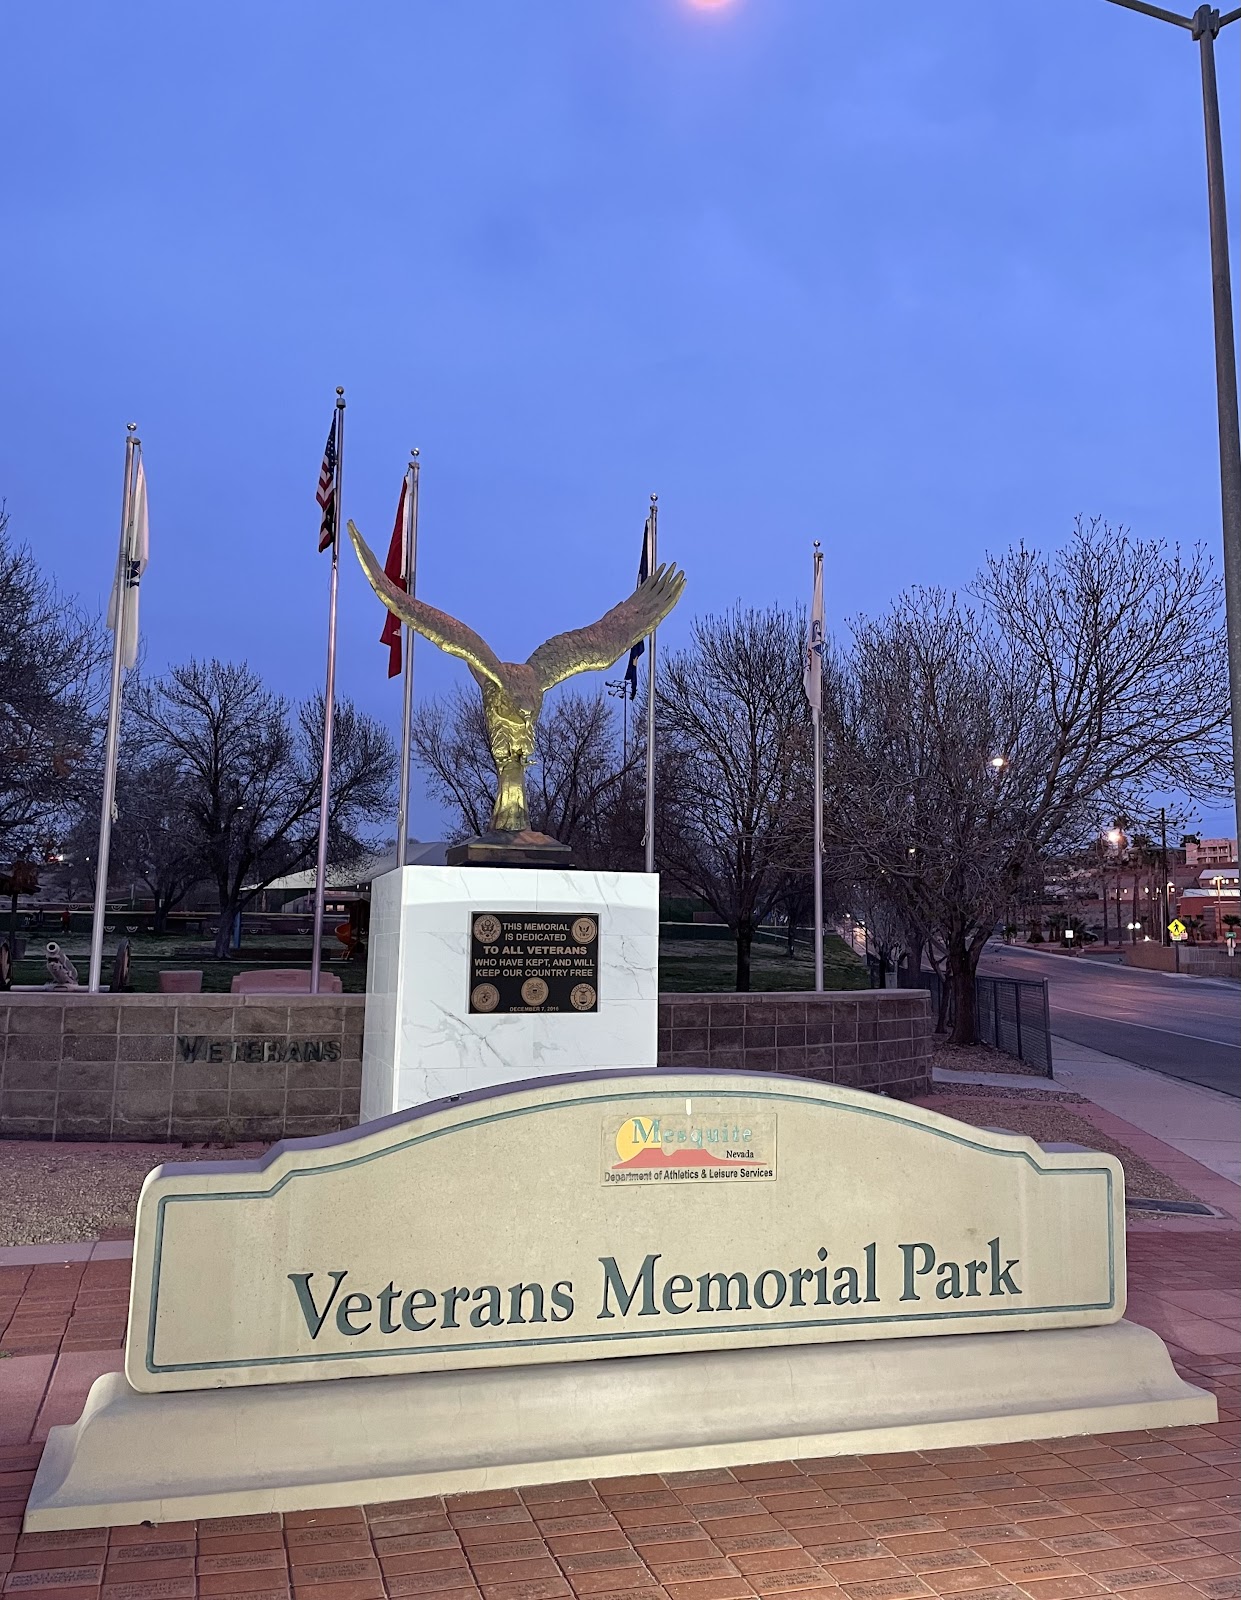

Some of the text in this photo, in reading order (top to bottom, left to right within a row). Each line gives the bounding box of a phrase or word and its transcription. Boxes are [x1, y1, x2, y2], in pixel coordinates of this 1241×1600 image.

[502, 922, 570, 931] THIS MEMORIAL
[505, 933, 567, 941] IS DEDICATED
[483, 945, 587, 955] TO ALL VETERANS
[474, 958, 497, 966] WHO
[499, 958, 523, 966] HAVE
[525, 959, 551, 967] KEPT,
[475, 969, 593, 977] KEEP OUR COUNTRY FREE
[177, 1036, 341, 1063] VETERANS
[631, 1118, 754, 1148] Mesquite
[726, 1150, 754, 1159] Nevada
[604, 1167, 773, 1184] Department of Athletics & Leisure Services
[287, 1237, 1023, 1340] Veterans Memorial Park
